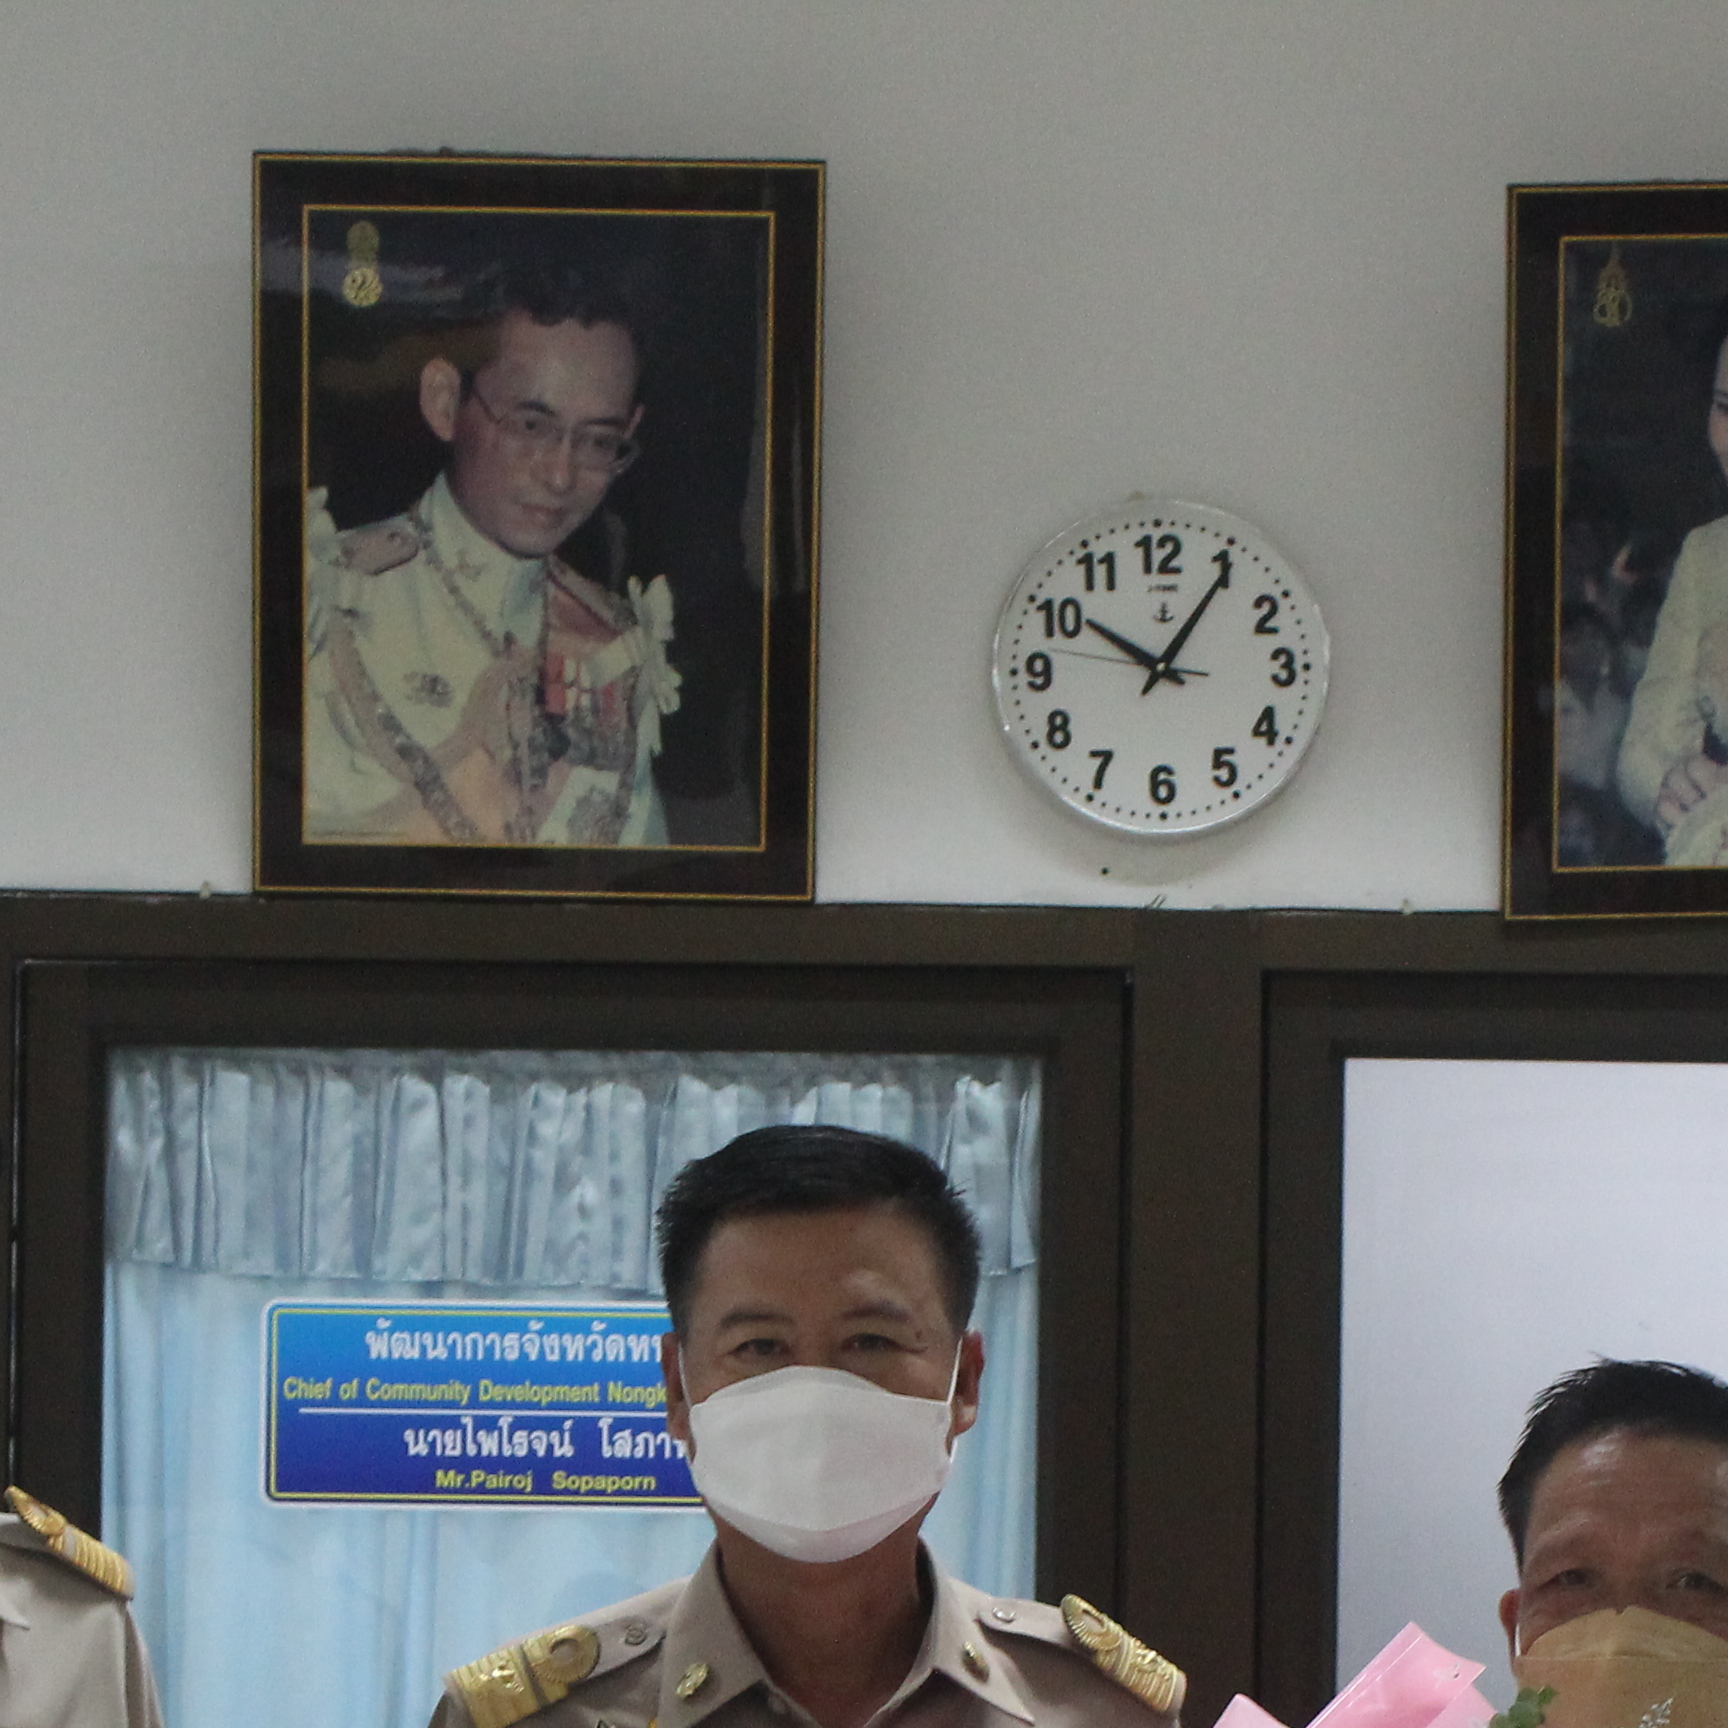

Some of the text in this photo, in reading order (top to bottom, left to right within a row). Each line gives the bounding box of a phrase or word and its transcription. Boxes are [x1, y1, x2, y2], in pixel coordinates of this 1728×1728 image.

[1076, 549, 1234, 592] 11 1
[1134, 534, 1183, 576] 12
[1035, 594, 1281, 640] 10 2
[1025, 647, 1297, 692] 9 3
[1045, 705, 1279, 750] 8 4
[1088, 747, 1239, 791] 7 5
[1148, 764, 1177, 806] 6
[283, 1376, 333, 1401] Chief
[339, 1377, 360, 1401] of
[365, 1378, 471, 1407] Community
[478, 1379, 600, 1408] Development
[403, 1416, 575, 1459] นายไพโรจน์
[435, 1469, 657, 1495] Mr.Pairoj Sopaporn
